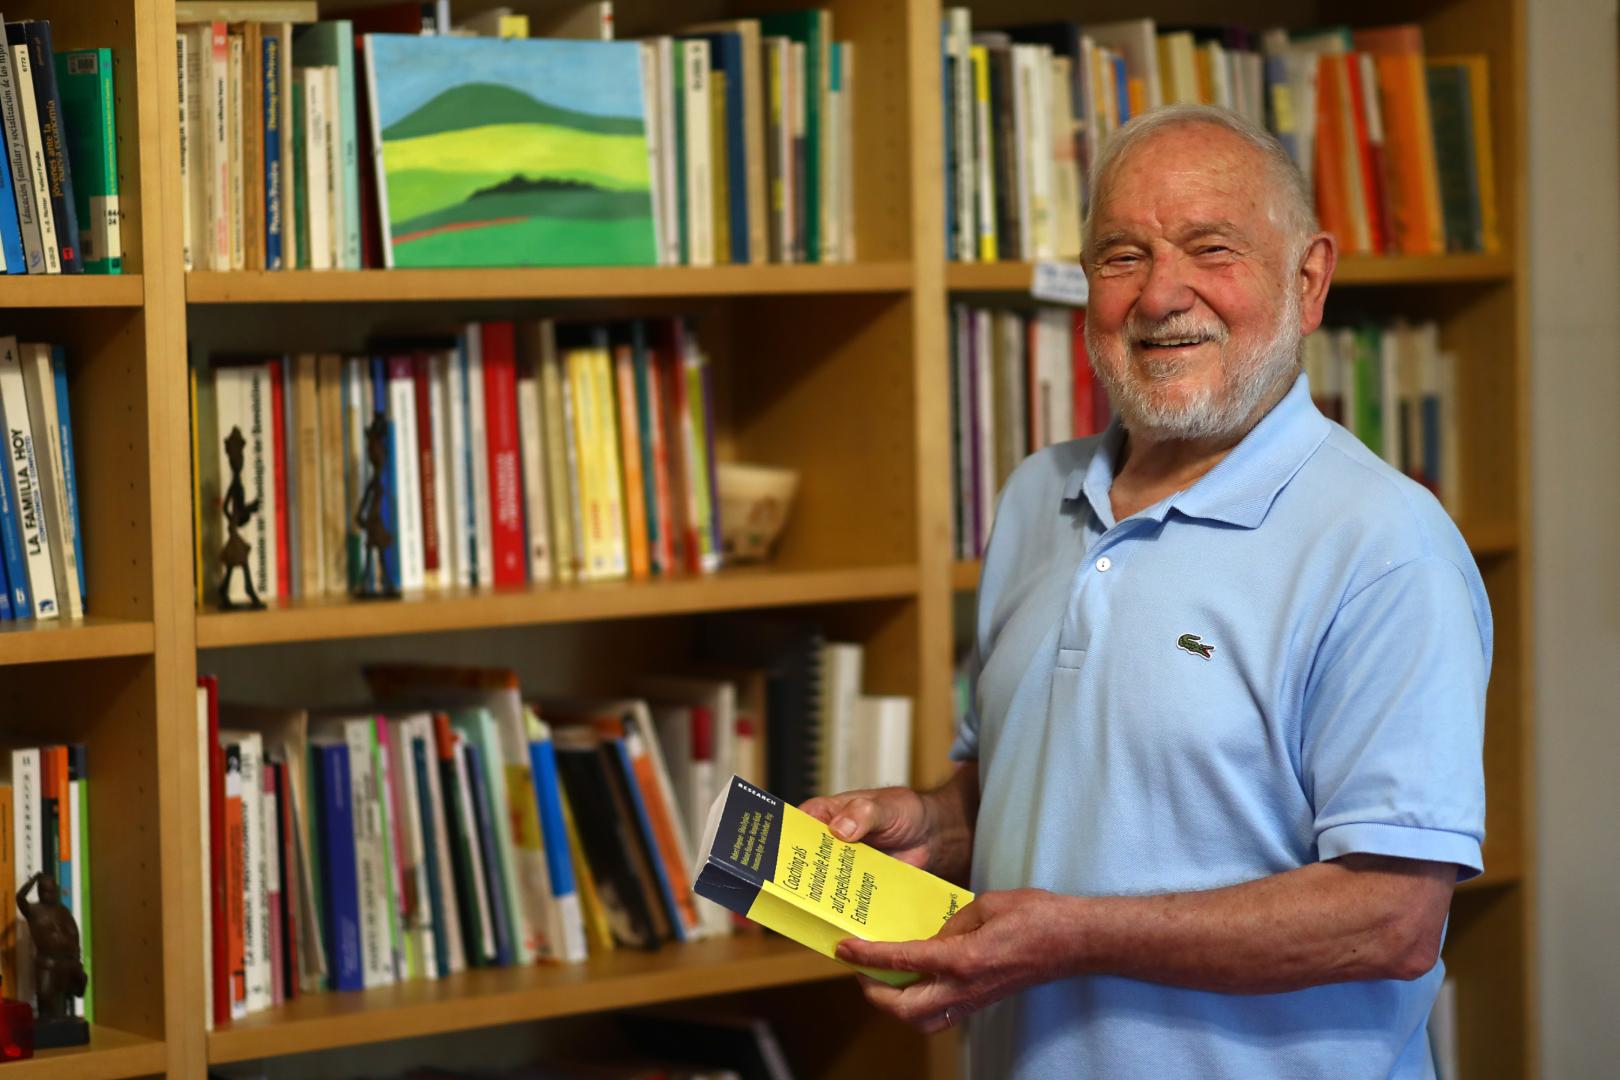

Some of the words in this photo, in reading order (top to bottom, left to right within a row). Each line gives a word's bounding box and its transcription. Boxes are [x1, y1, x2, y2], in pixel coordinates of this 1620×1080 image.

[0, 61, 8, 77] los
[1, 79, 10, 88] de
[5, 90, 19, 142] socialización
[47, 134, 57, 158] ante
[13, 151, 30, 182] familiar
[20, 183, 32, 224] Educación
[11, 429, 26, 461] HOY
[18, 467, 36, 530] FAMILIA
[28, 534, 41, 556] LA
[737, 782, 776, 806] RESEARCH
[792, 846, 807, 860] als
[816, 833, 834, 861] Antwort
[783, 857, 809, 890] Coaching
[806, 859, 829, 902] individuelle
[835, 845, 856, 903] gesellschaftliche
[830, 895, 845, 914] auf
[850, 872, 877, 925] Entwicklungen
